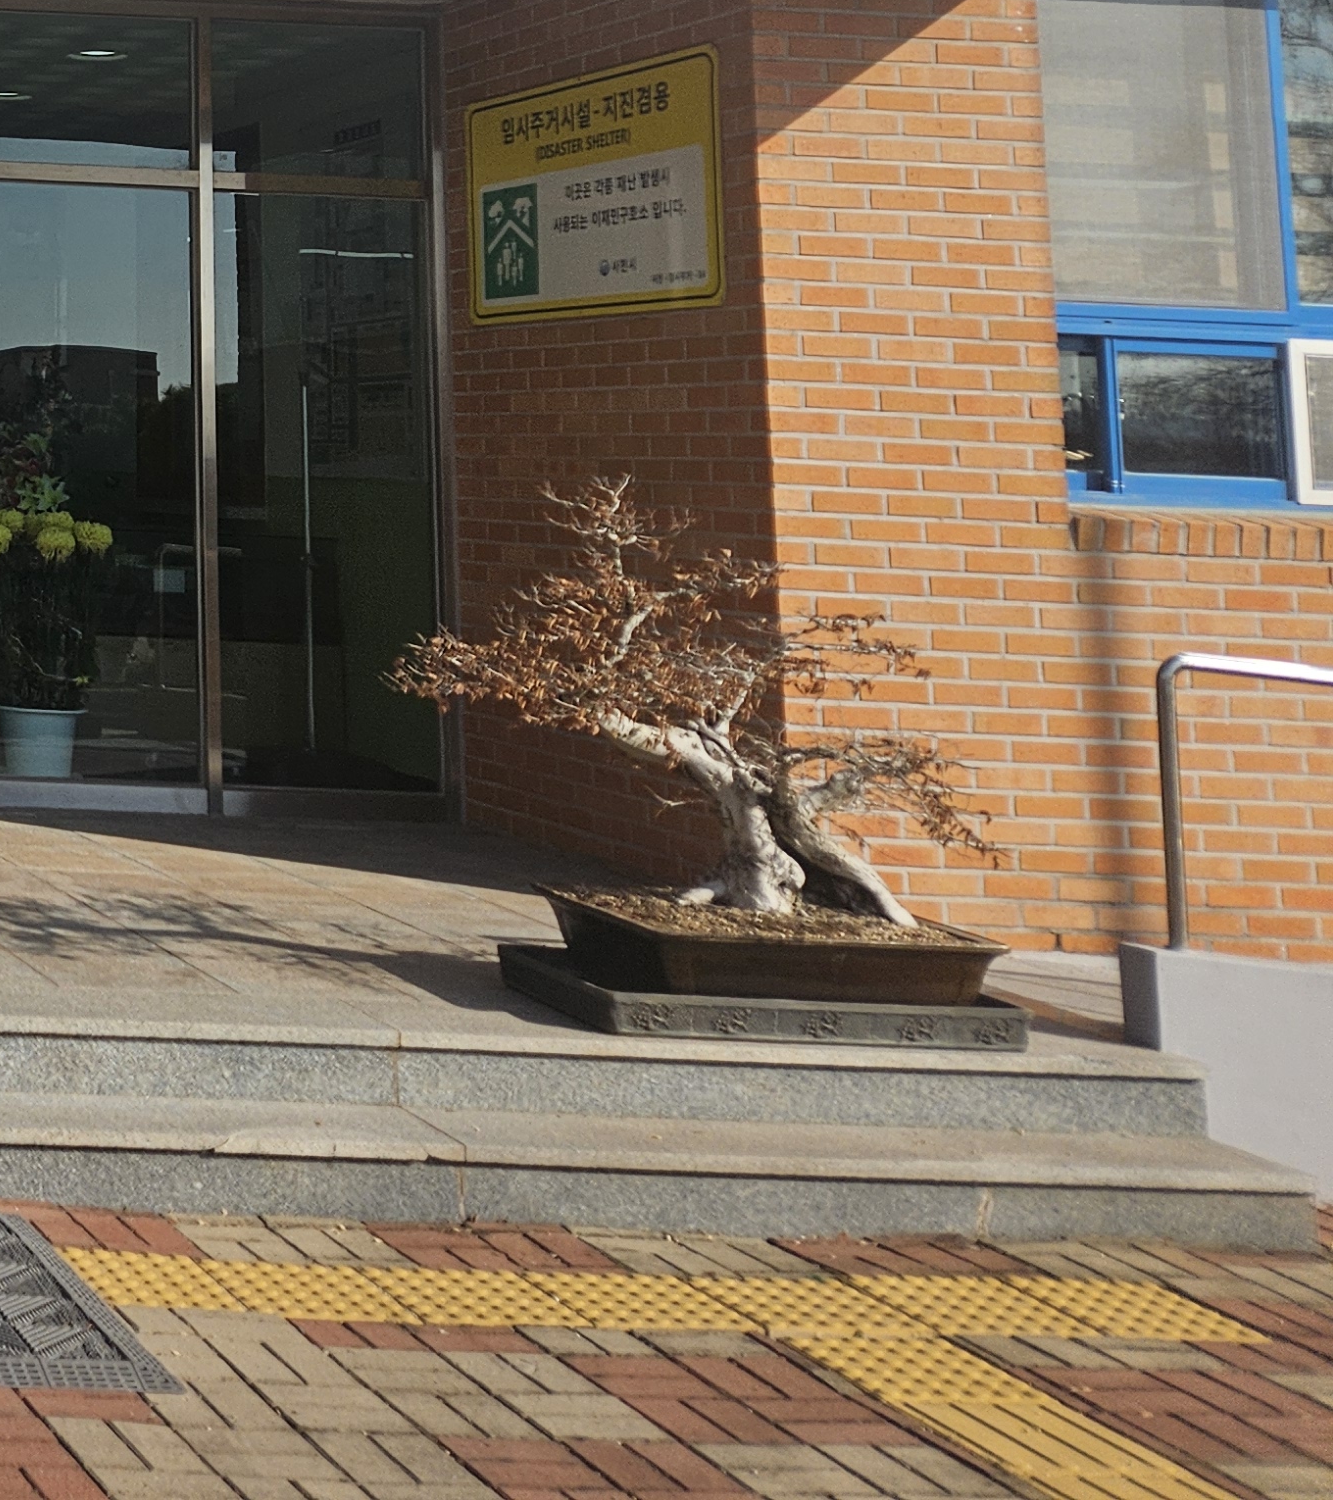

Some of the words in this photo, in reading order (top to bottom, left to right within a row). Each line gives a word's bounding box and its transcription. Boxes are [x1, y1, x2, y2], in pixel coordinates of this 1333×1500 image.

[535, 137, 584, 161] (DISASTER
[585, 127, 632, 152] SHELTER)
[564, 181, 592, 201] 이곳은
[616, 172, 637, 192] 재난
[553, 213, 589, 234] 사용되는
